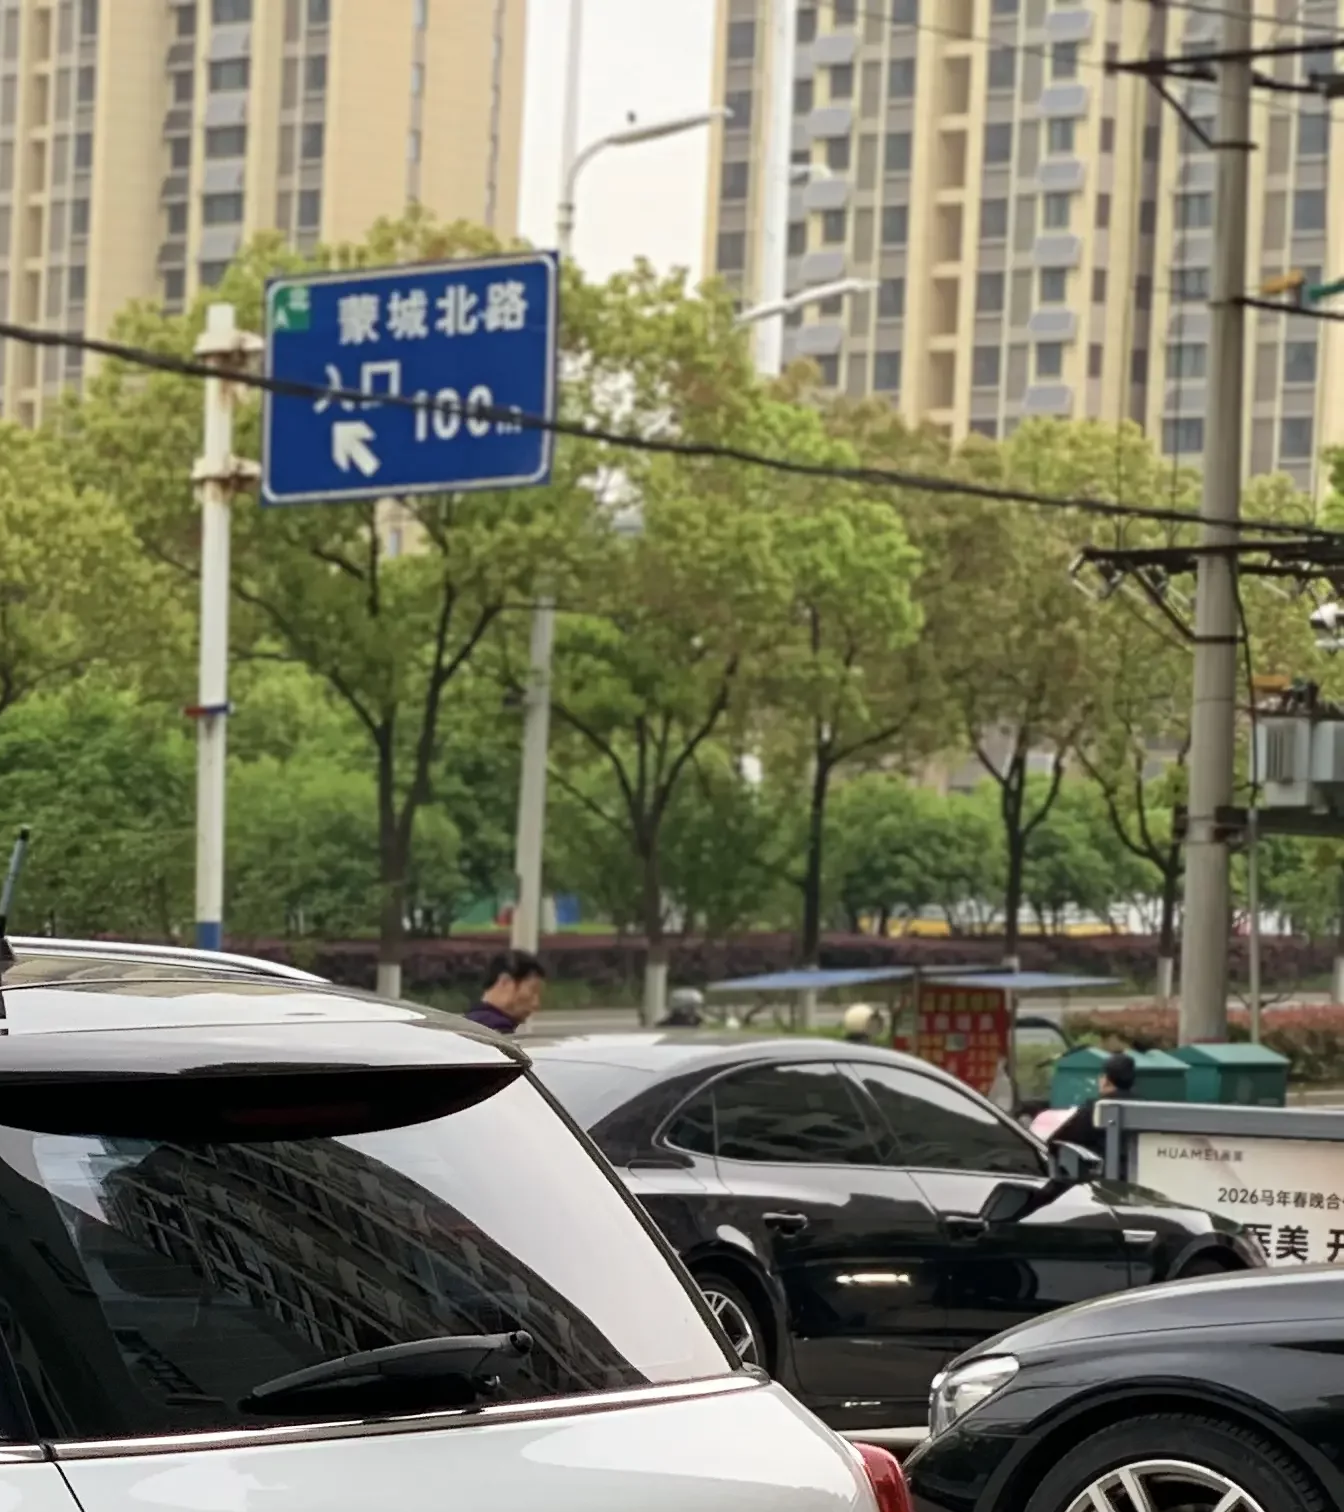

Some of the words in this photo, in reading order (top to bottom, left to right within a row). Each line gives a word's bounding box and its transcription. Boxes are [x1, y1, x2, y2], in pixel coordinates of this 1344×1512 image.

[313, 360, 401, 414] 入口
[1218, 1187, 1344, 1211] 2026马年春晚合
